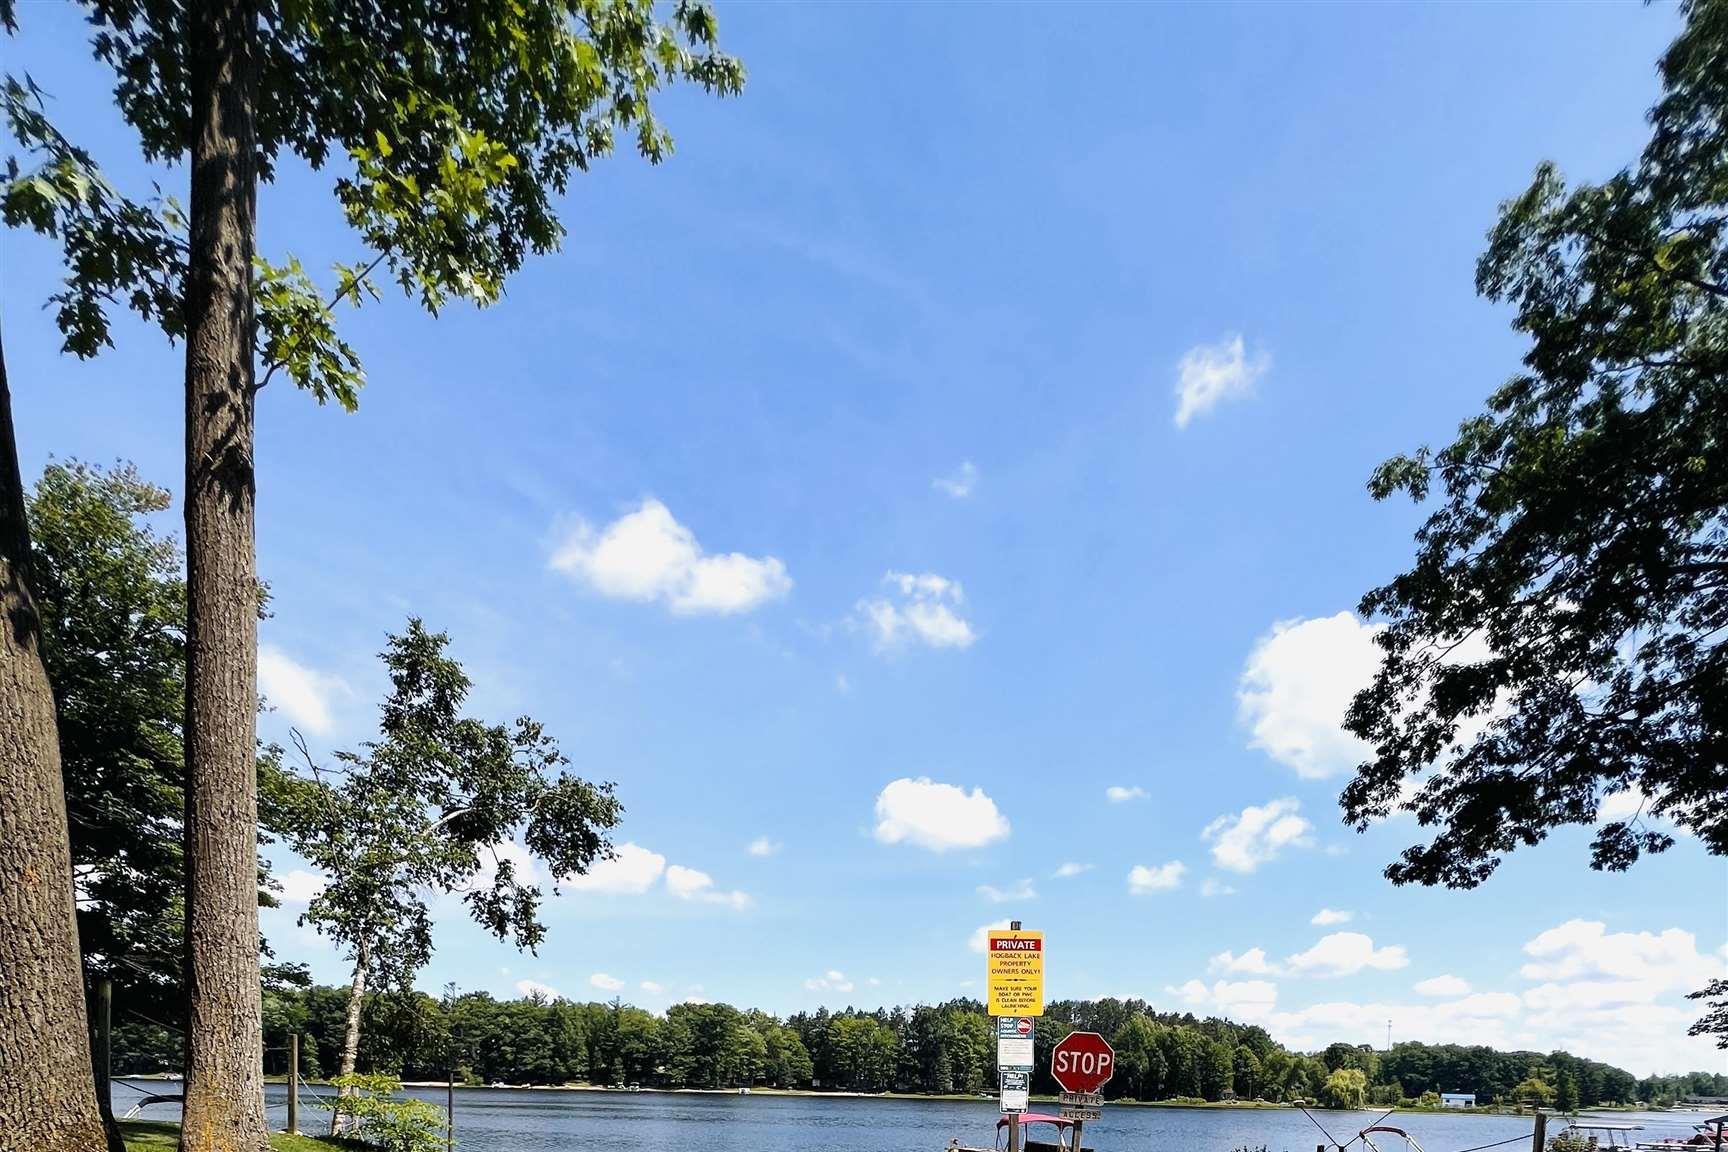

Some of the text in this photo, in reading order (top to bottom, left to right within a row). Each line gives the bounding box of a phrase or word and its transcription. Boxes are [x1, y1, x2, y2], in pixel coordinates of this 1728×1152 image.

[996, 940, 1035, 949] PRIVATE
[1056, 1050, 1111, 1075] STOP
[1063, 1093, 1101, 1105] PRIVATE
[1063, 1110, 1099, 1119] ACCESS
